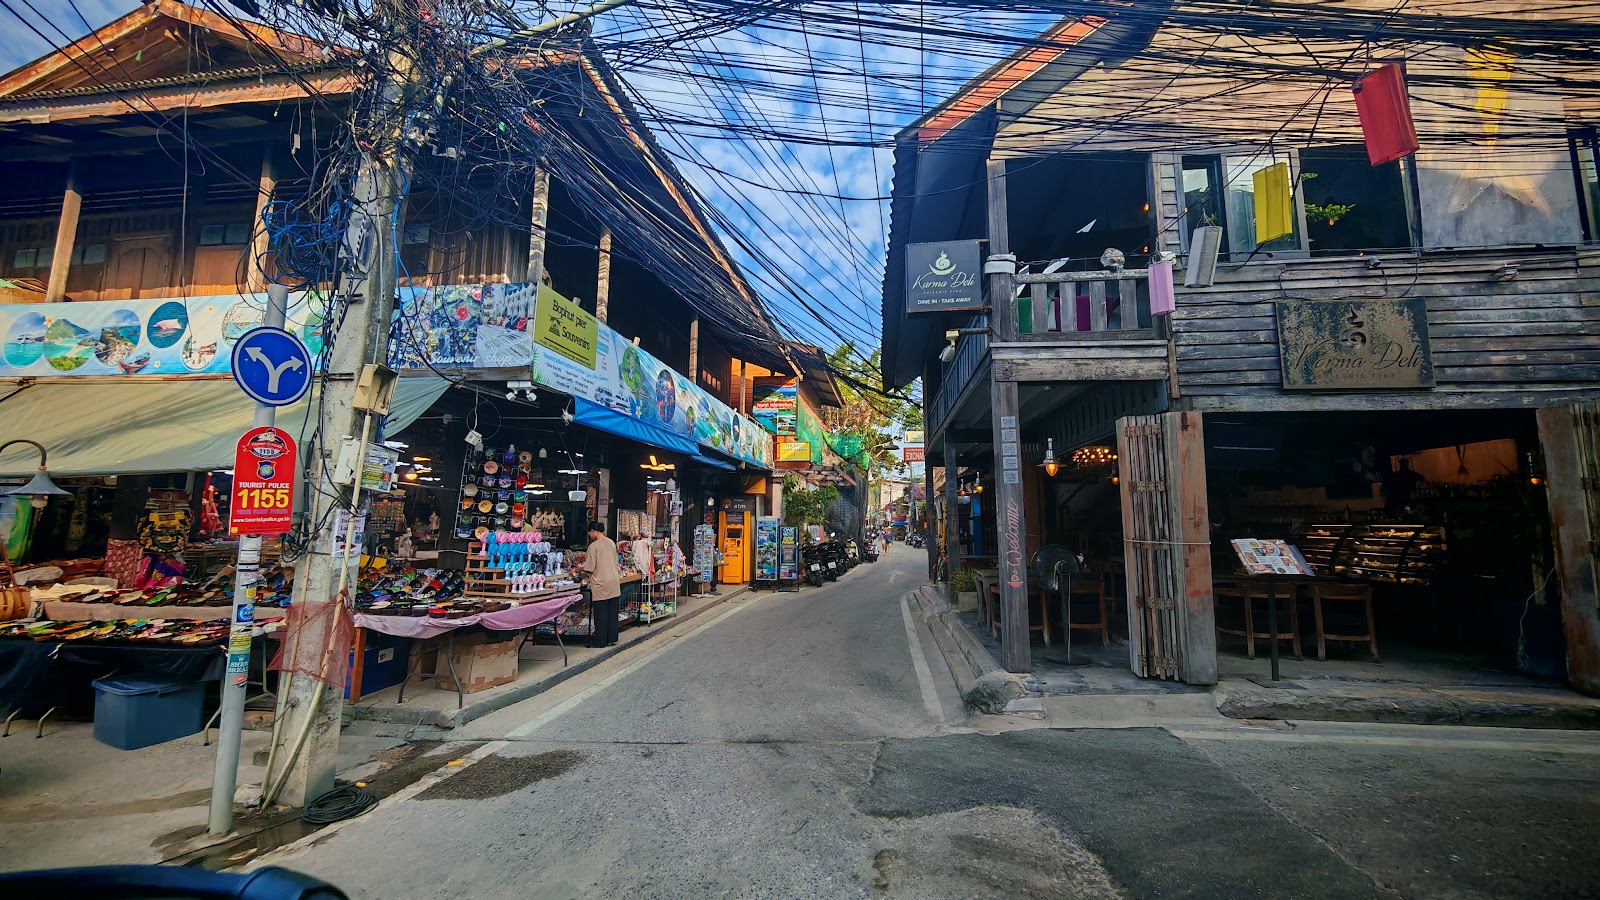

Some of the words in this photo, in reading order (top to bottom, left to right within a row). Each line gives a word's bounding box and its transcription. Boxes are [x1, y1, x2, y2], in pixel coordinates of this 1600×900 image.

[912, 271, 948, 291] Karma
[950, 271, 976, 288] Deli
[552, 299, 575, 323] Bophut
[575, 315, 588, 329] pier
[562, 326, 591, 351] Souvenirs
[429, 351, 480, 365] Souvenir
[484, 350, 512, 367] shop
[1294, 338, 1367, 371] Karma
[1371, 340, 1421, 371] Deli
[239, 481, 266, 489] TOURIST
[237, 488, 290, 509] 1155
[733, 501, 746, 509] atm
[1005, 497, 1023, 571] Welcome
